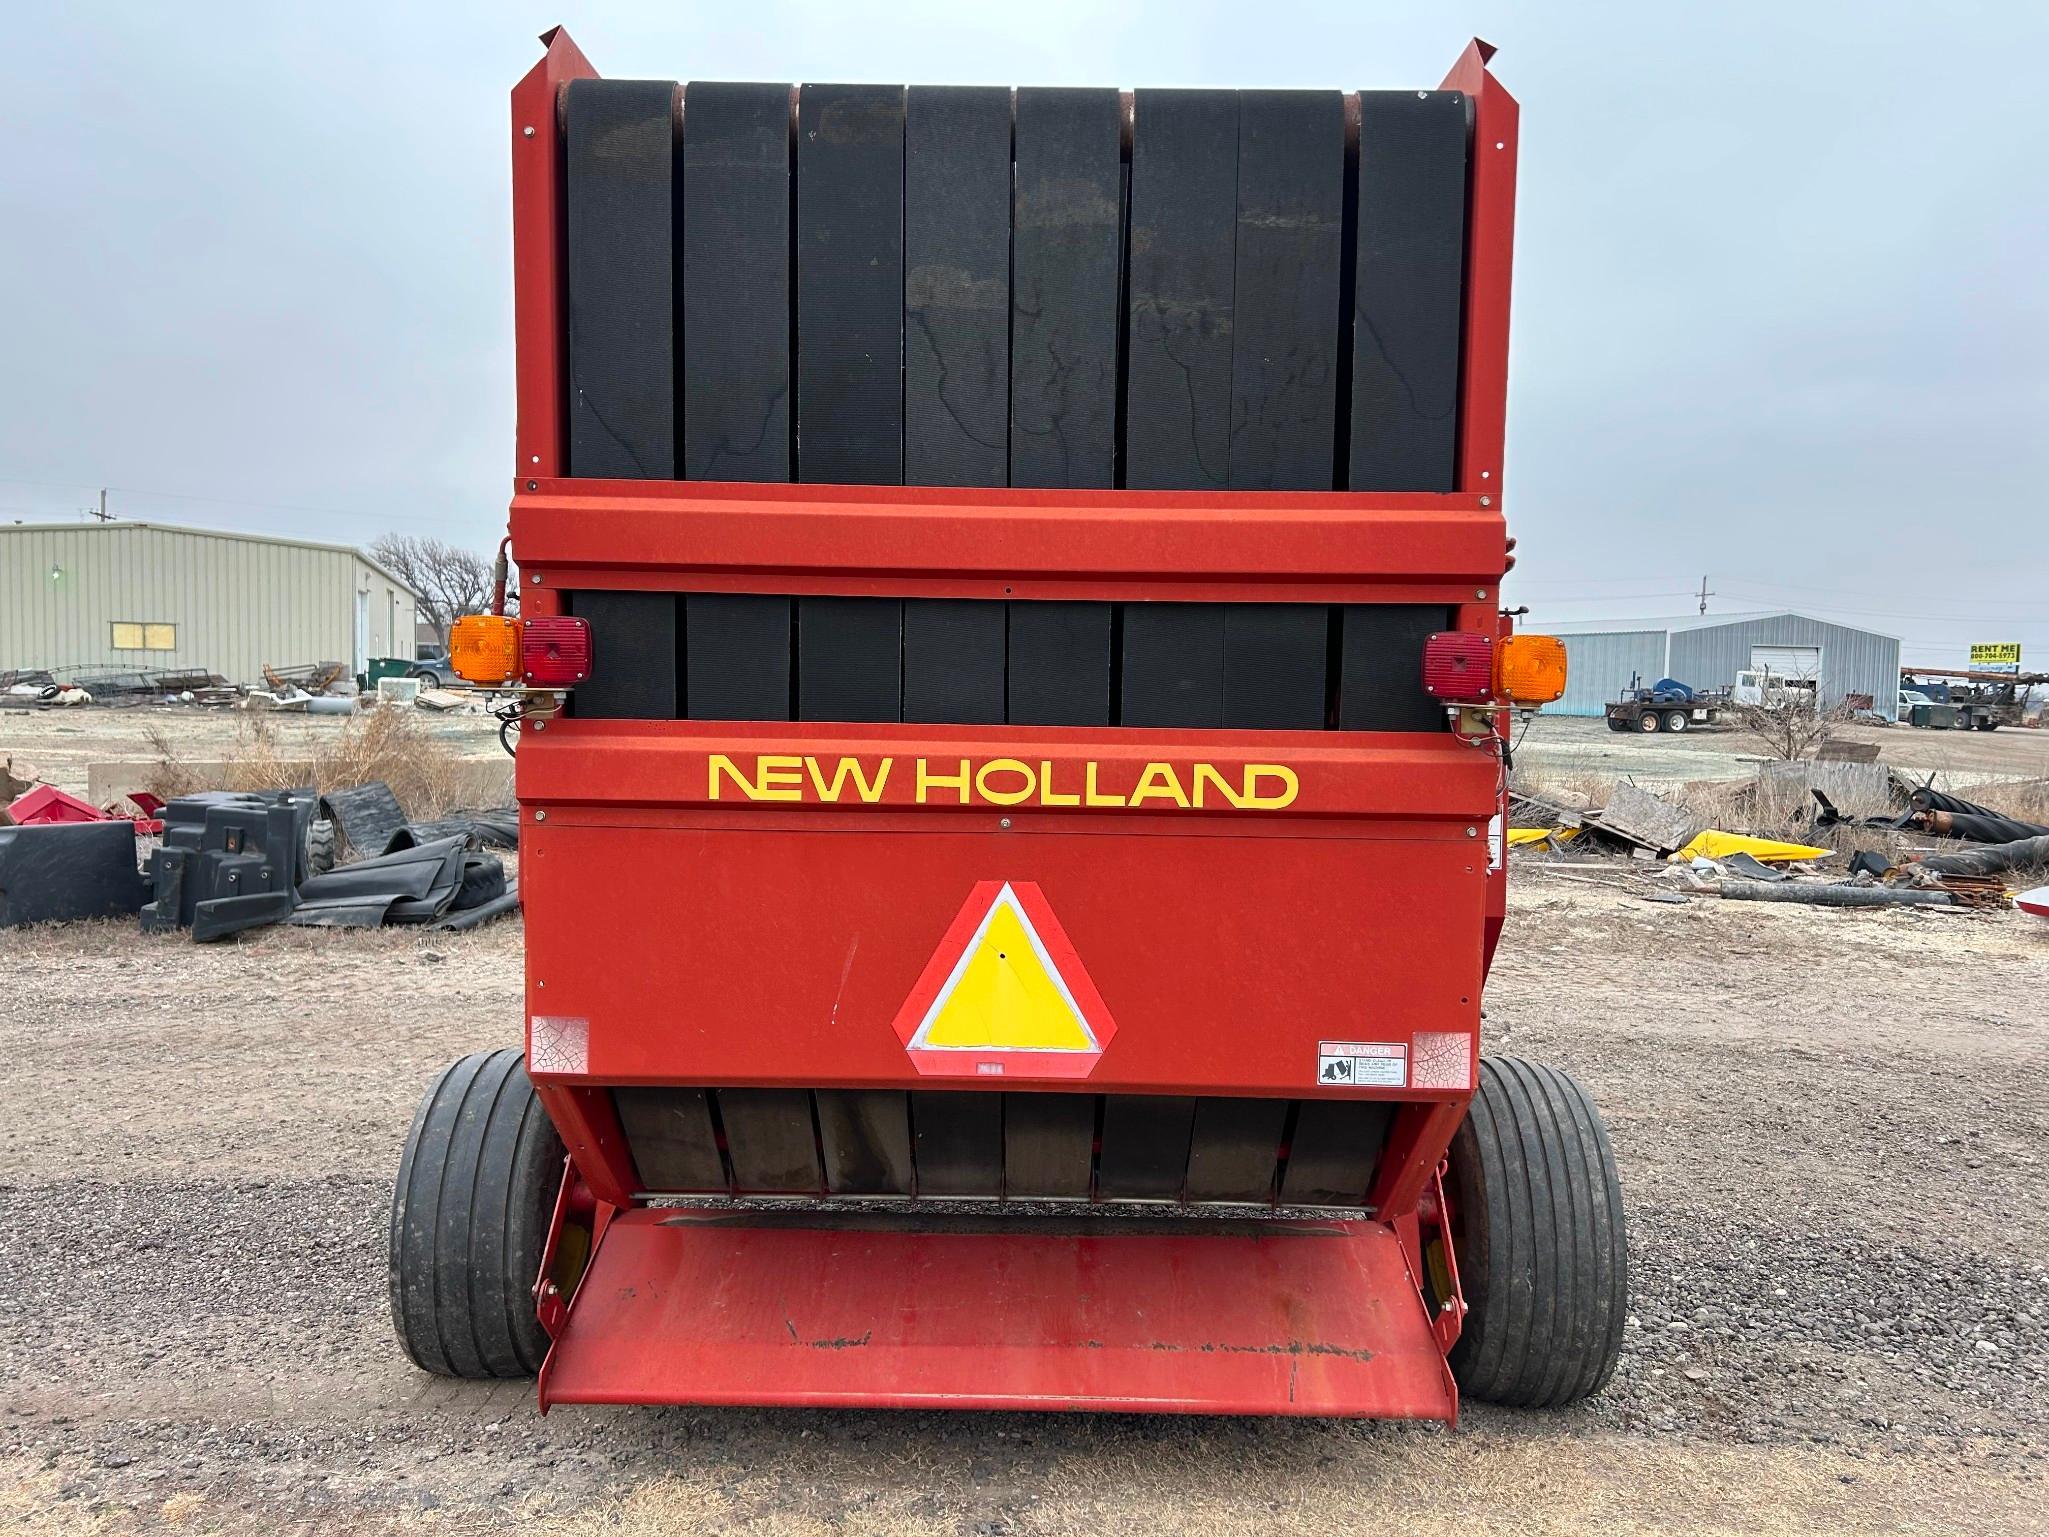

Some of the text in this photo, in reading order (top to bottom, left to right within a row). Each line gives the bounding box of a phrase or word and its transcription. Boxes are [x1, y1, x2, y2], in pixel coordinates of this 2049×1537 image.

[709, 755, 1298, 809] NEW HOLLAND
[1349, 1046, 1392, 1056] DANGER
